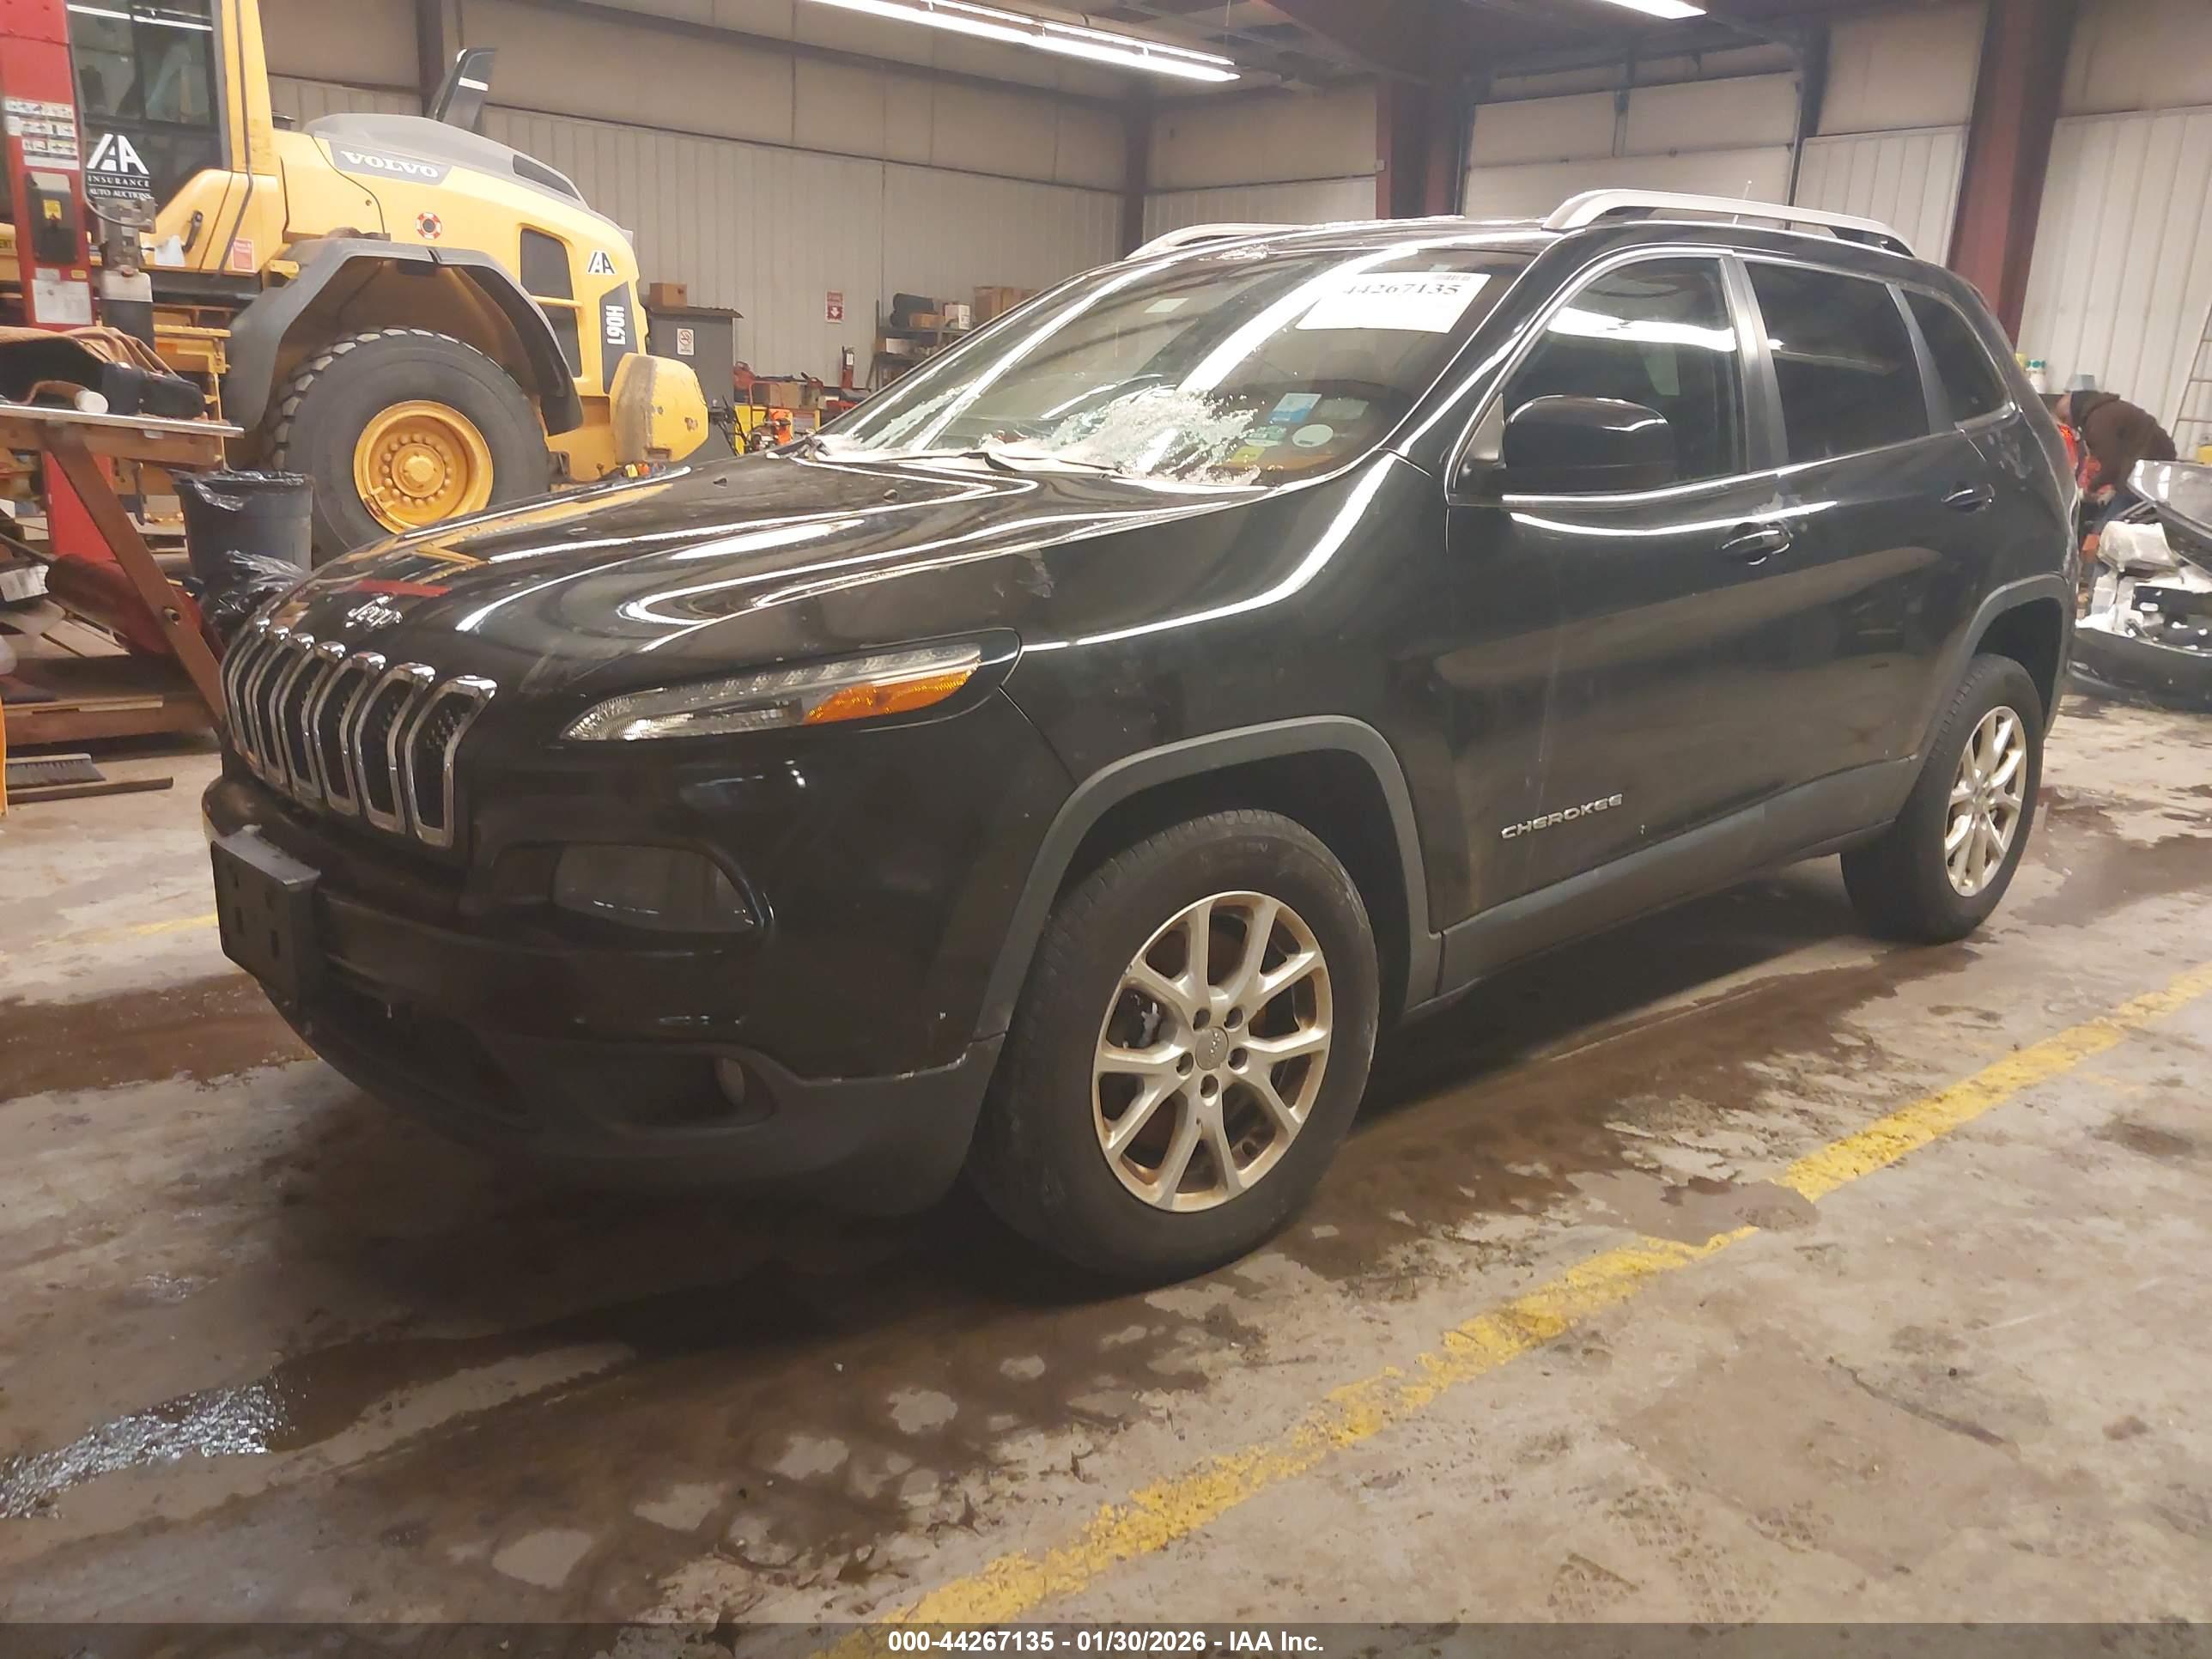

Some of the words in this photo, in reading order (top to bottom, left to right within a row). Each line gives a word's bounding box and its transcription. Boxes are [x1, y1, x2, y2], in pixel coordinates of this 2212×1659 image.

[340, 150, 439, 179] VOLVO
[88, 175, 149, 187] INSURANCE
[88, 188, 112, 197] AUTO
[1342, 283, 1462, 295] 44267135
[605, 305, 626, 345] L90H
[345, 595, 404, 632] Jeep
[1501, 793, 1623, 839] CHEROKEE
